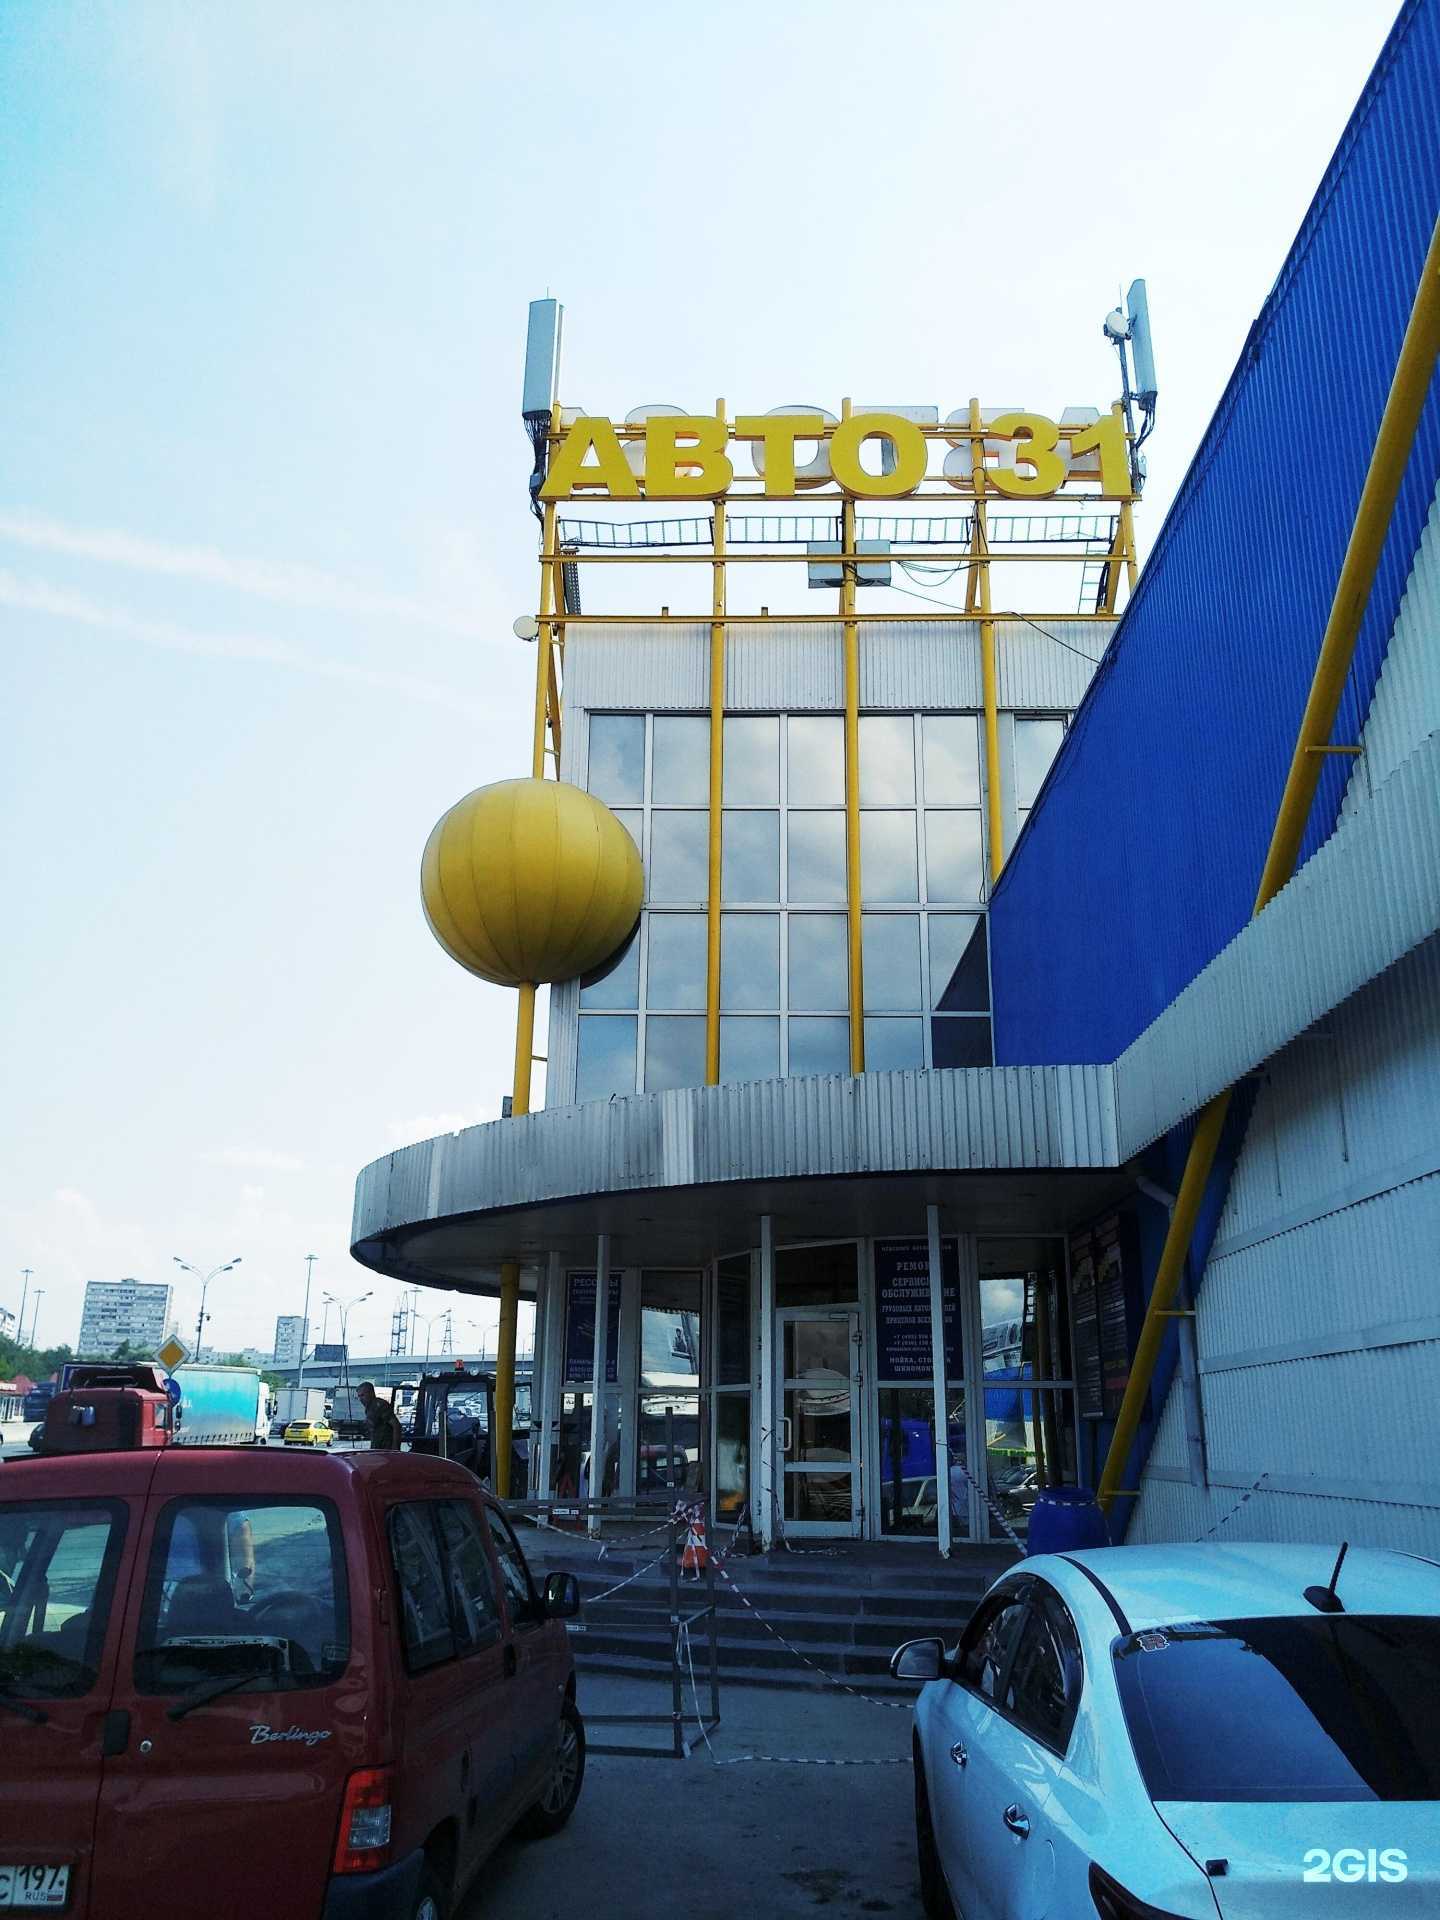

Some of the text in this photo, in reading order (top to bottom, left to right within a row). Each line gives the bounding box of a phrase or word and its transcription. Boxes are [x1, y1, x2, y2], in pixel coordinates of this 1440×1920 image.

[538, 412, 1134, 499] АВТО 31
[896, 1261, 930, 1271] РЕМО
[249, 1724, 333, 1746] Berlingo
[19, 1865, 61, 1890] 197
[25, 1891, 46, 1902] RUS
